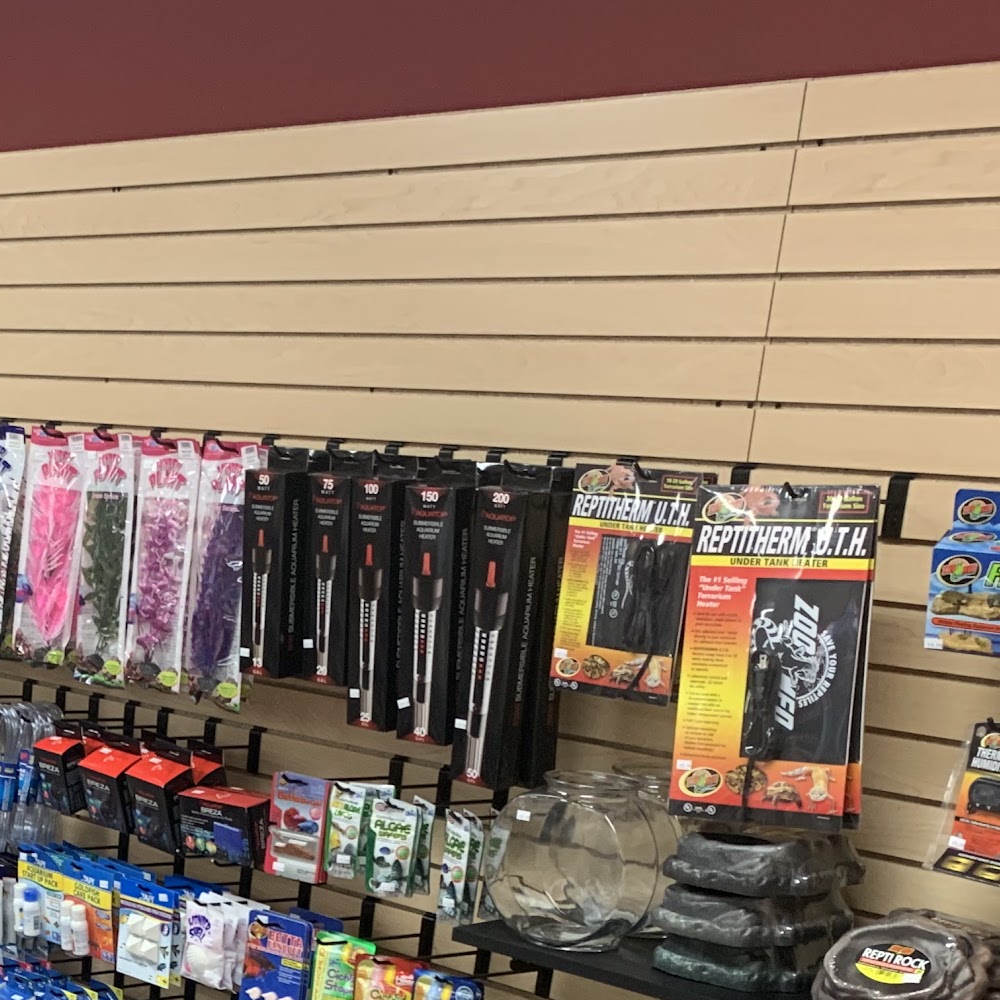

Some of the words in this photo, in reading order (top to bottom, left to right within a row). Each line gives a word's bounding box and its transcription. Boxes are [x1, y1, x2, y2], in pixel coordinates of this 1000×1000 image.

[259, 475, 269, 485] 50
[323, 479, 334, 489] 75
[364, 484, 379, 494] 100
[421, 491, 439, 502] 150
[492, 493, 510, 504] 200
[572, 494, 654, 522] REPTITHERM
[696, 524, 811, 555] REPTITHERM
[290, 532, 298, 576] AQUARIUM
[730, 558, 761, 566] UNDER
[764, 558, 789, 567] TANK
[699, 575, 712, 583] The
[723, 576, 748, 586] Selling
[522, 593, 532, 640] AQUARIUM
[528, 557, 536, 592] HEATER
[820, 630, 836, 651] SAVE
[827, 653, 837, 680] YOUR
[798, 680, 831, 709] REPTILES
[413, 727, 426, 737] 40
[466, 768, 478, 778] 50
[135, 794, 158, 808] BREZA
[201, 806, 223, 817] BREZA
[374, 820, 411, 835] ALGAE
[22, 870, 37, 881] START
[37, 875, 43, 884] UP
[43, 877, 58, 888] PACK
[26, 865, 53, 881] AQUARIUM
[73, 888, 85, 899] CARE
[85, 891, 101, 904] PACK
[74, 881, 100, 896] GOLDFISH
[269, 931, 302, 947] BETTA
[862, 948, 894, 963] REPTI
[894, 954, 930, 970] ROCK
